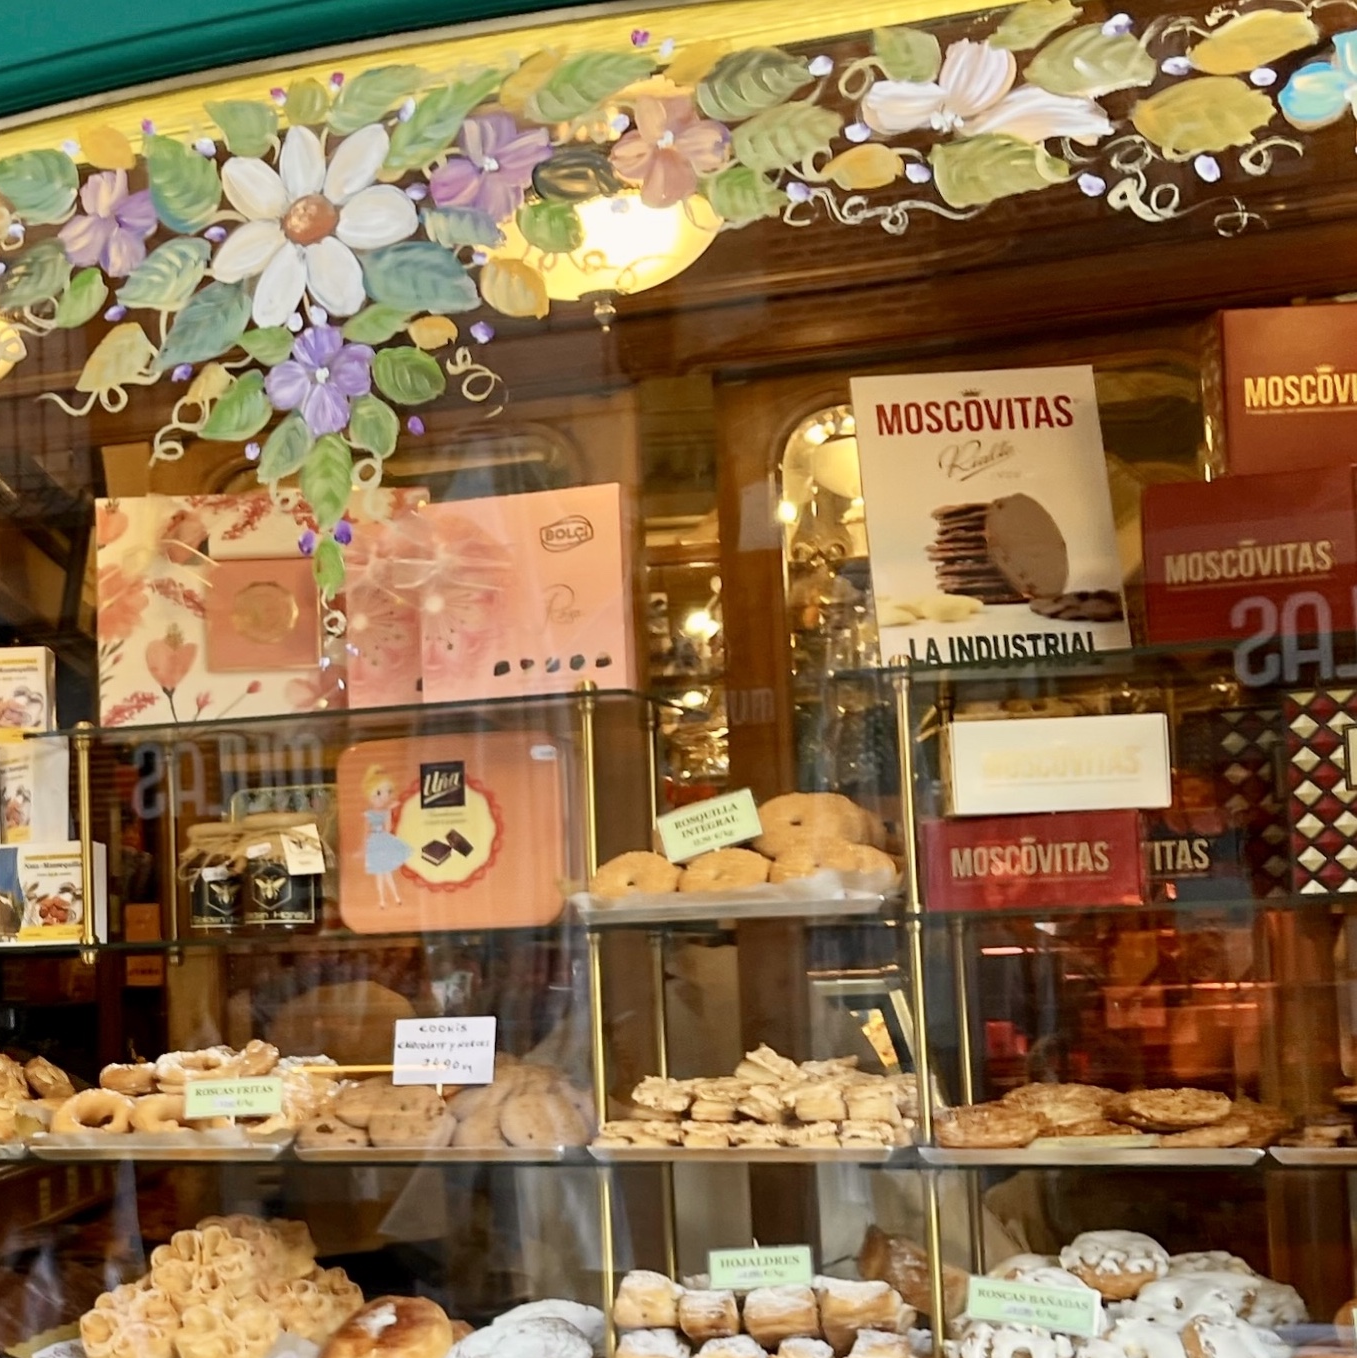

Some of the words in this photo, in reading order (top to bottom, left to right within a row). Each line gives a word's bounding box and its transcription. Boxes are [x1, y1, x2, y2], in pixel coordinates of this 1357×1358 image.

[909, 636, 944, 665] LA
[720, 1254, 801, 1268] HOJALDRES
[978, 1288, 1025, 1301] ROSCAS
